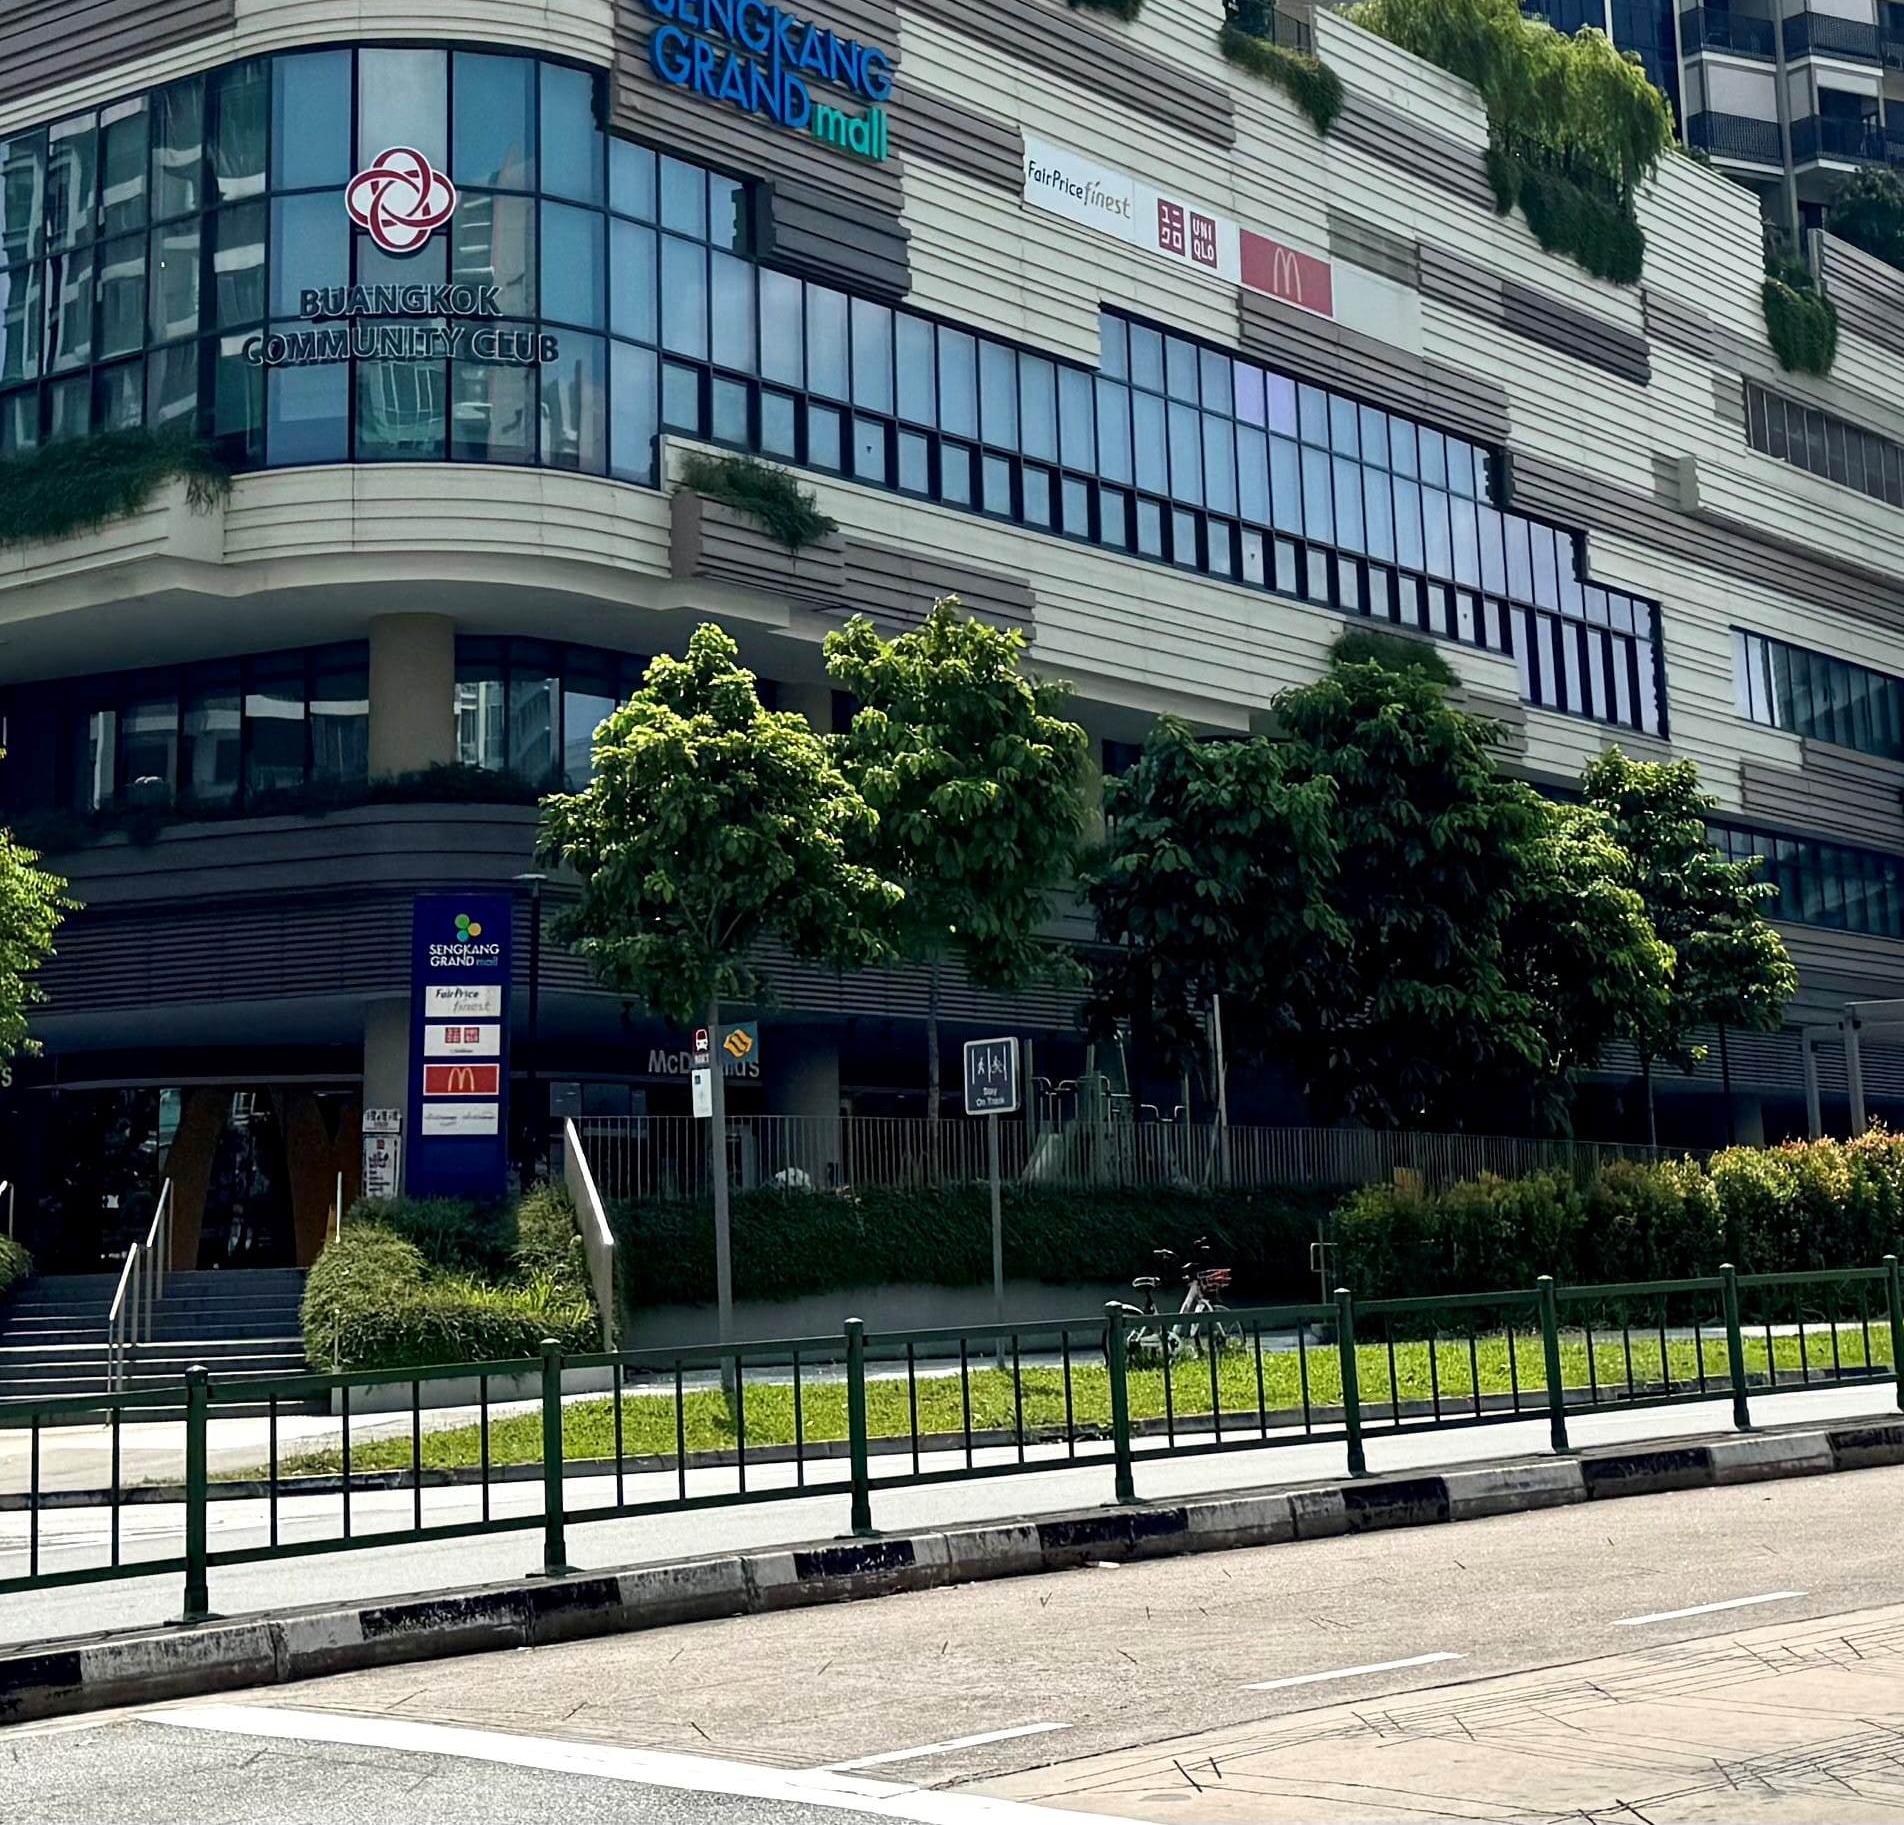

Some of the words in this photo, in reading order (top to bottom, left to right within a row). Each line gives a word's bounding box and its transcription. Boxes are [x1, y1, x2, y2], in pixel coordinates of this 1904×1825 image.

[652, 25, 811, 128] GRAND
[812, 105, 888, 162] mall
[1192, 218, 1212, 240] UNI
[1194, 239, 1215, 262] QLO
[300, 284, 504, 318] BUANGKOK
[242, 327, 465, 366] COMMUNITY
[471, 329, 560, 364] CLUB
[429, 944, 500, 956] SENGKANG
[430, 956, 475, 966] GRAND
